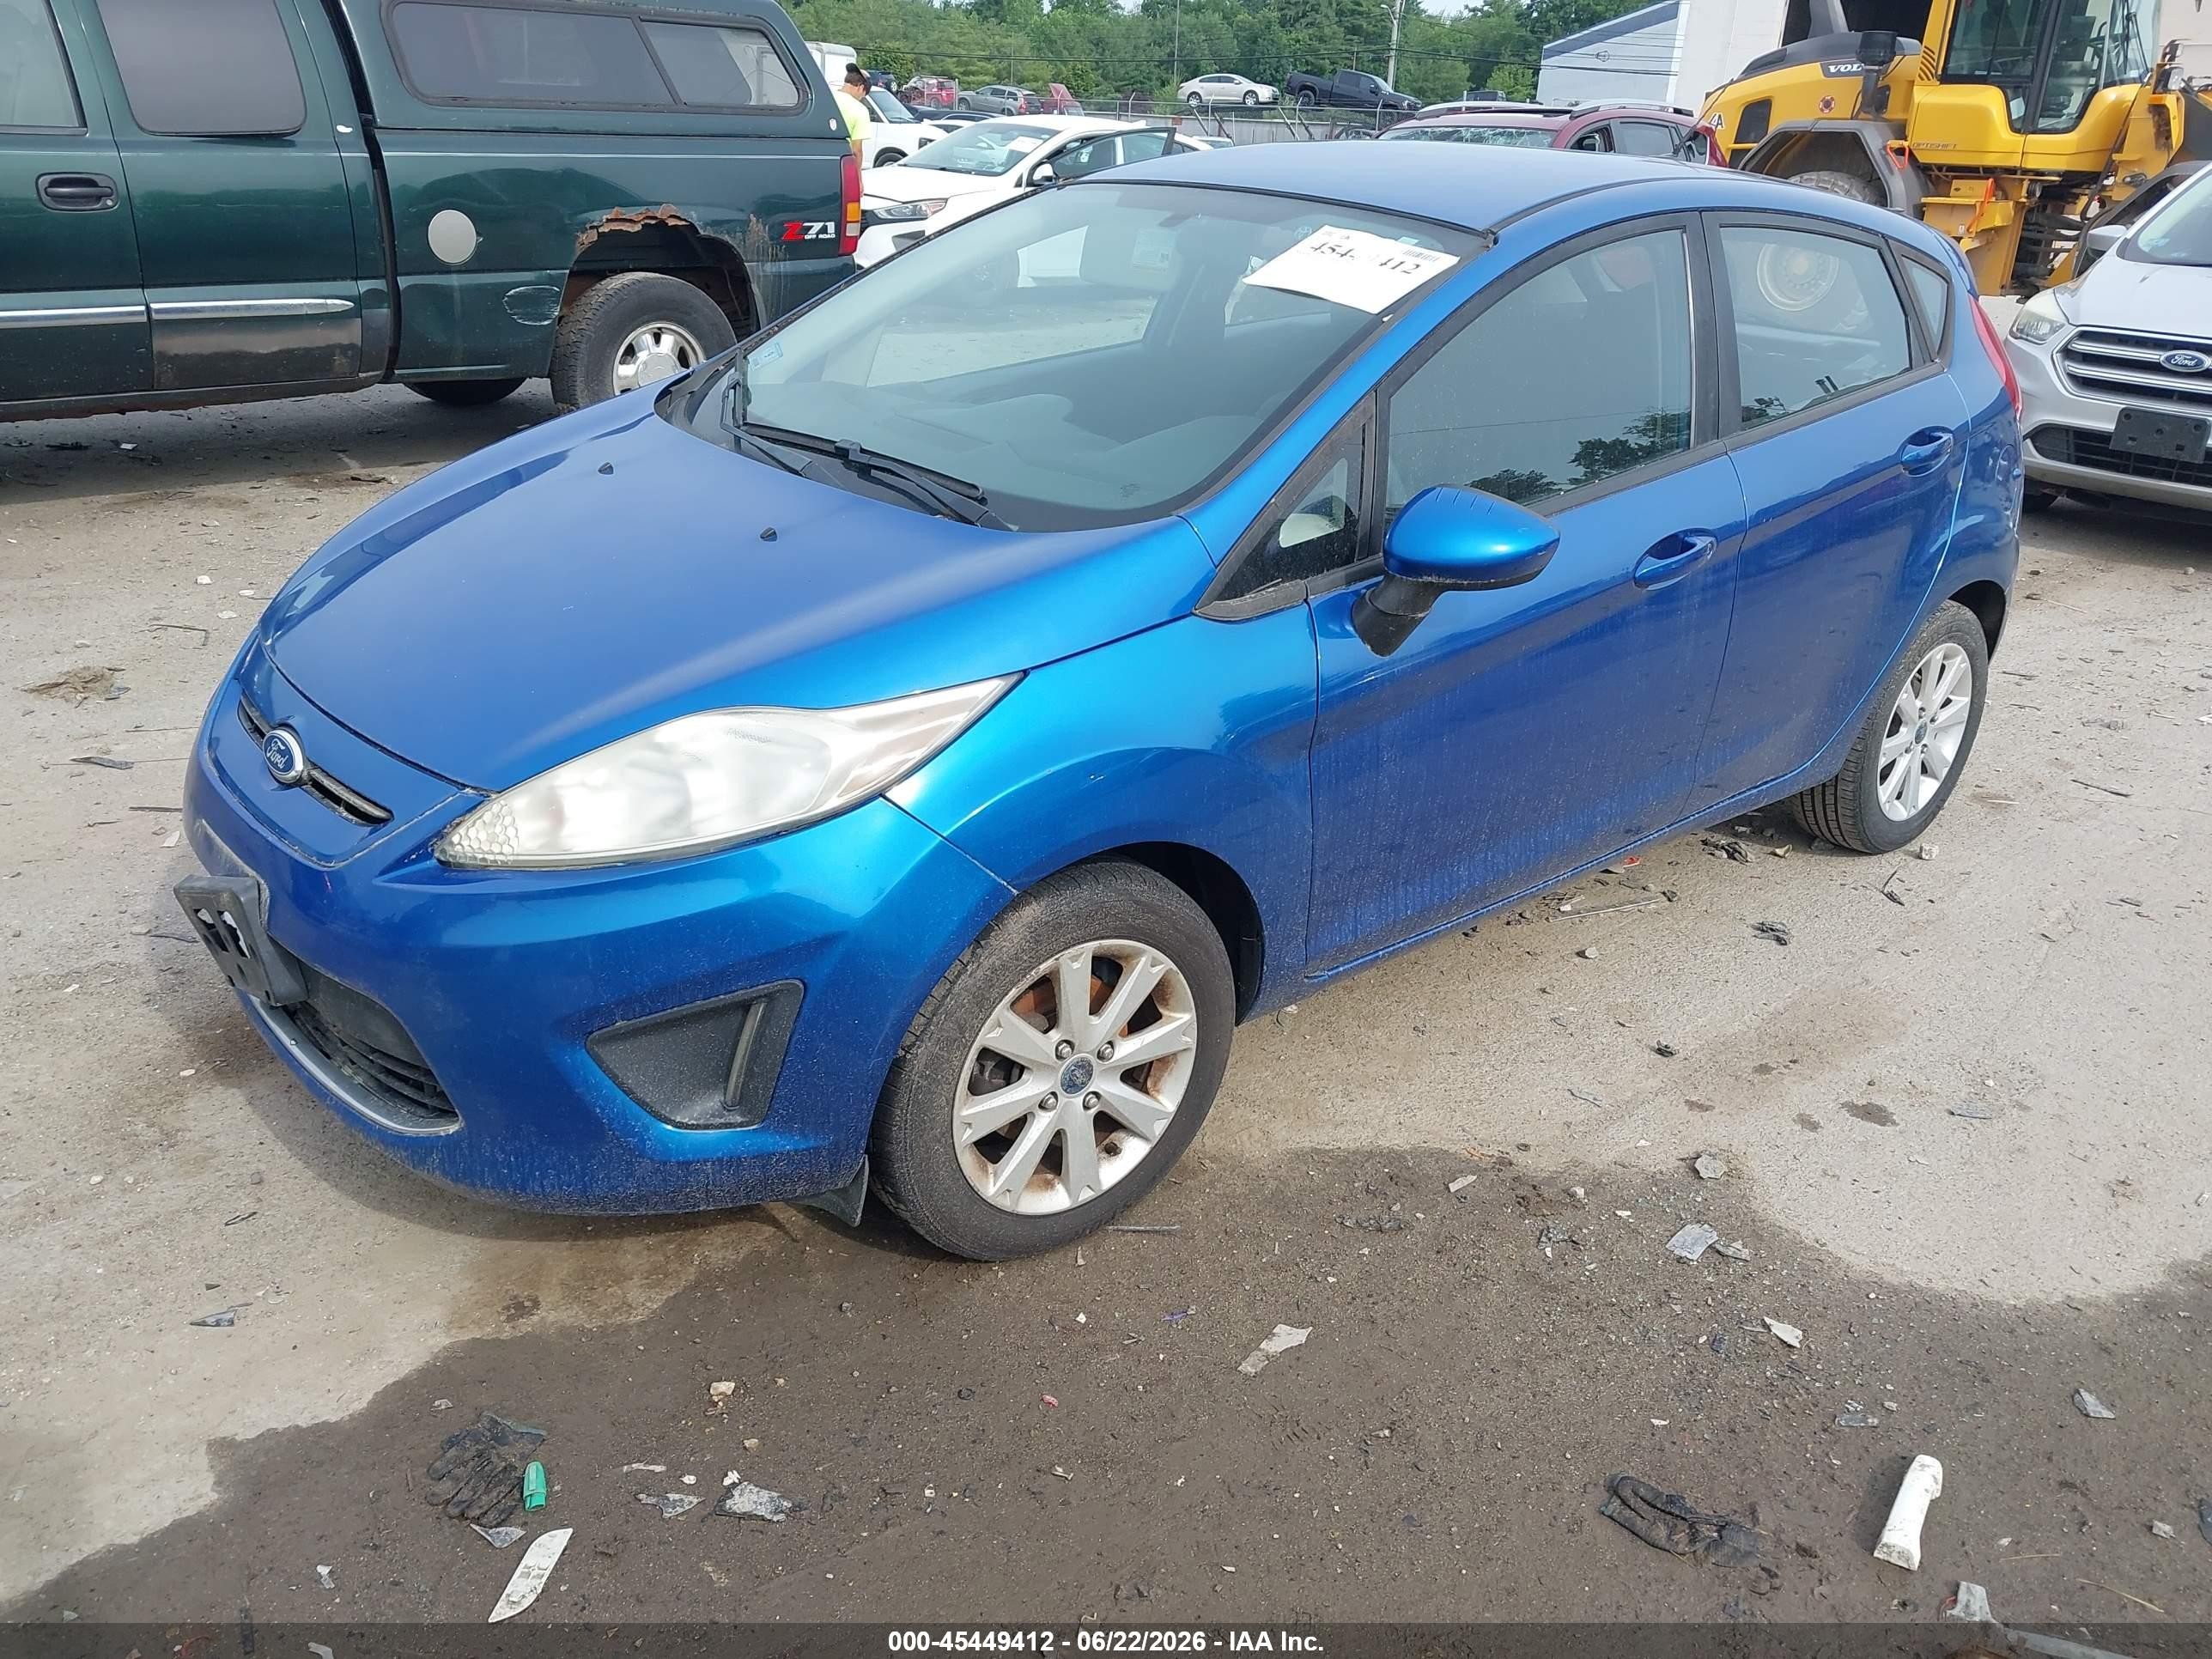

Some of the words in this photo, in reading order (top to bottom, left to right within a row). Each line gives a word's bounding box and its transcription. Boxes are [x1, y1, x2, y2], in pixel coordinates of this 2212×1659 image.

[1828, 64, 1864, 72] VOL
[783, 222, 836, 240] Z71
[2171, 355, 2197, 367] Ford
[267, 738, 289, 769] Ford
